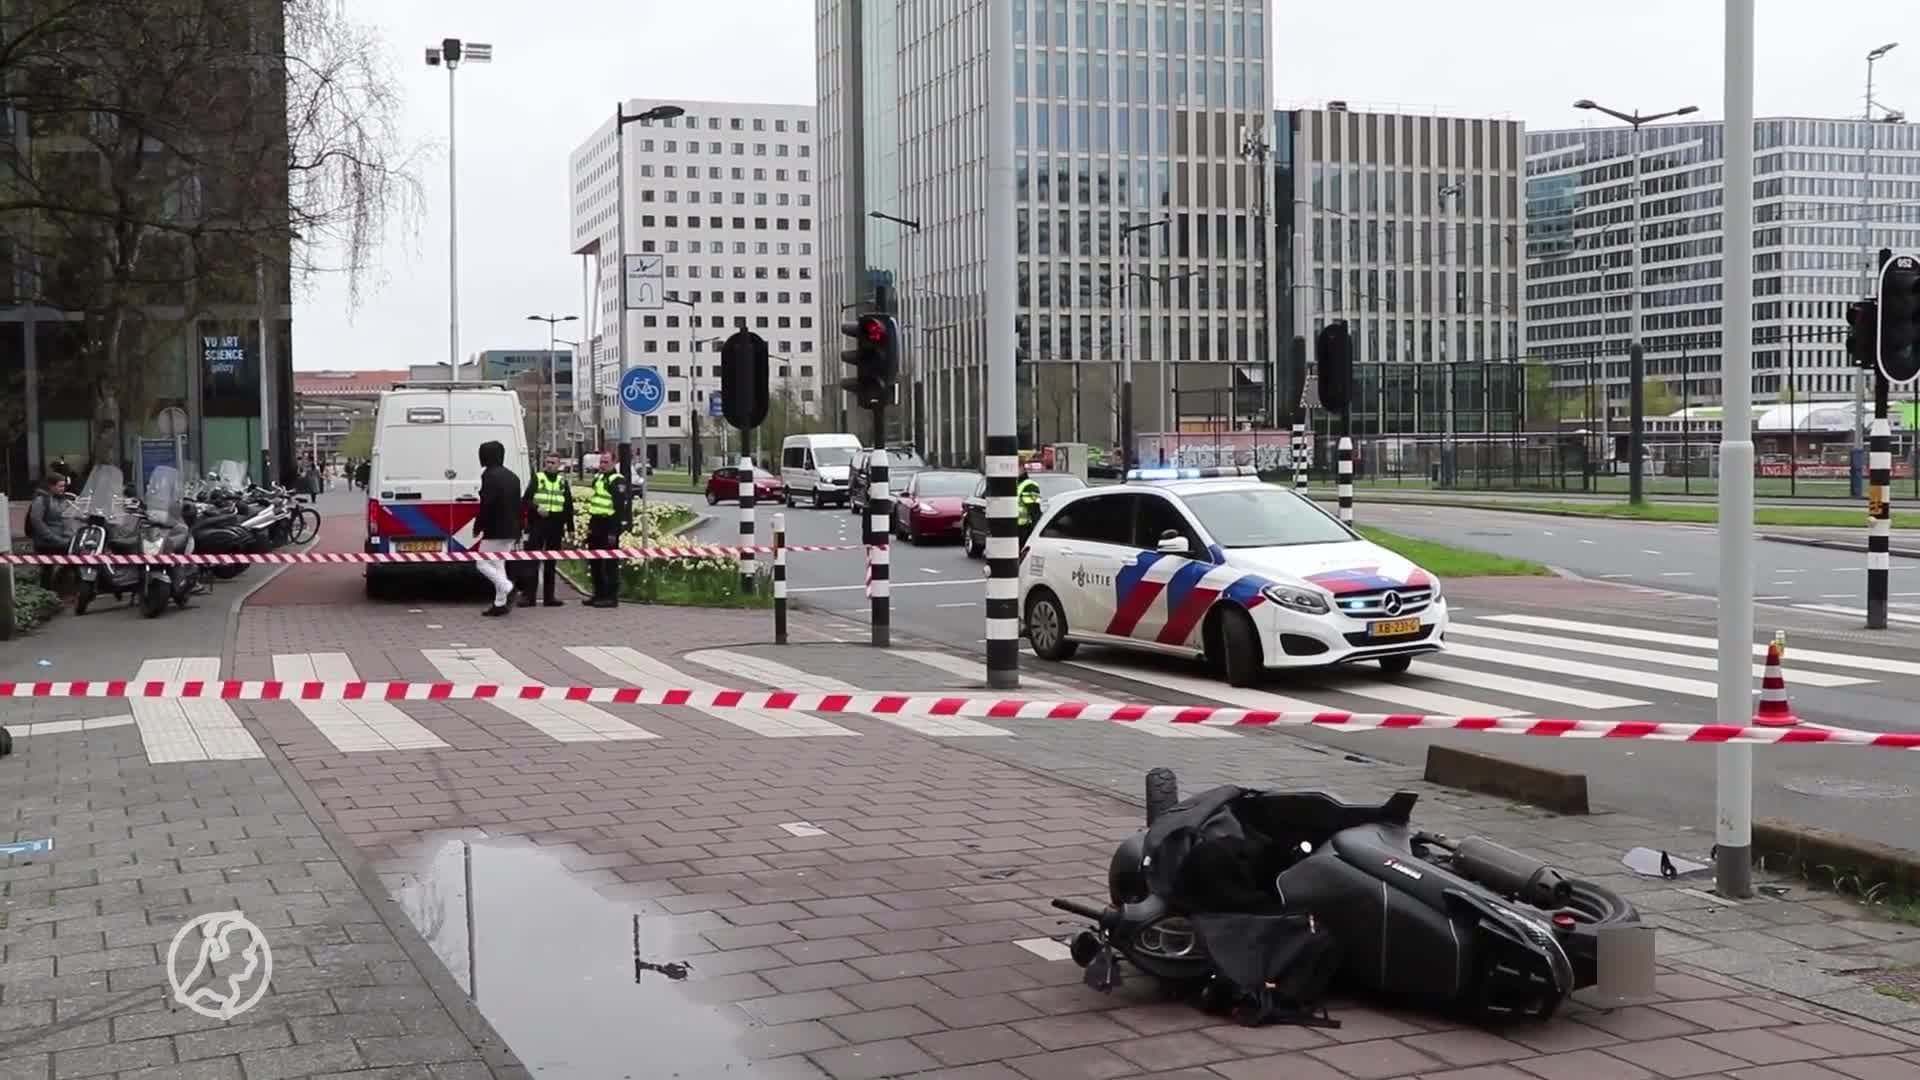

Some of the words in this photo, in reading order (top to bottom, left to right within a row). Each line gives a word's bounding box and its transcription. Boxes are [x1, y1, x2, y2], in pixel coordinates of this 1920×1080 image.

[204, 337, 218, 348] VU
[222, 336, 239, 348] ART
[204, 349, 245, 361] SCIENCE
[1072, 565, 1111, 587] POLITIE
